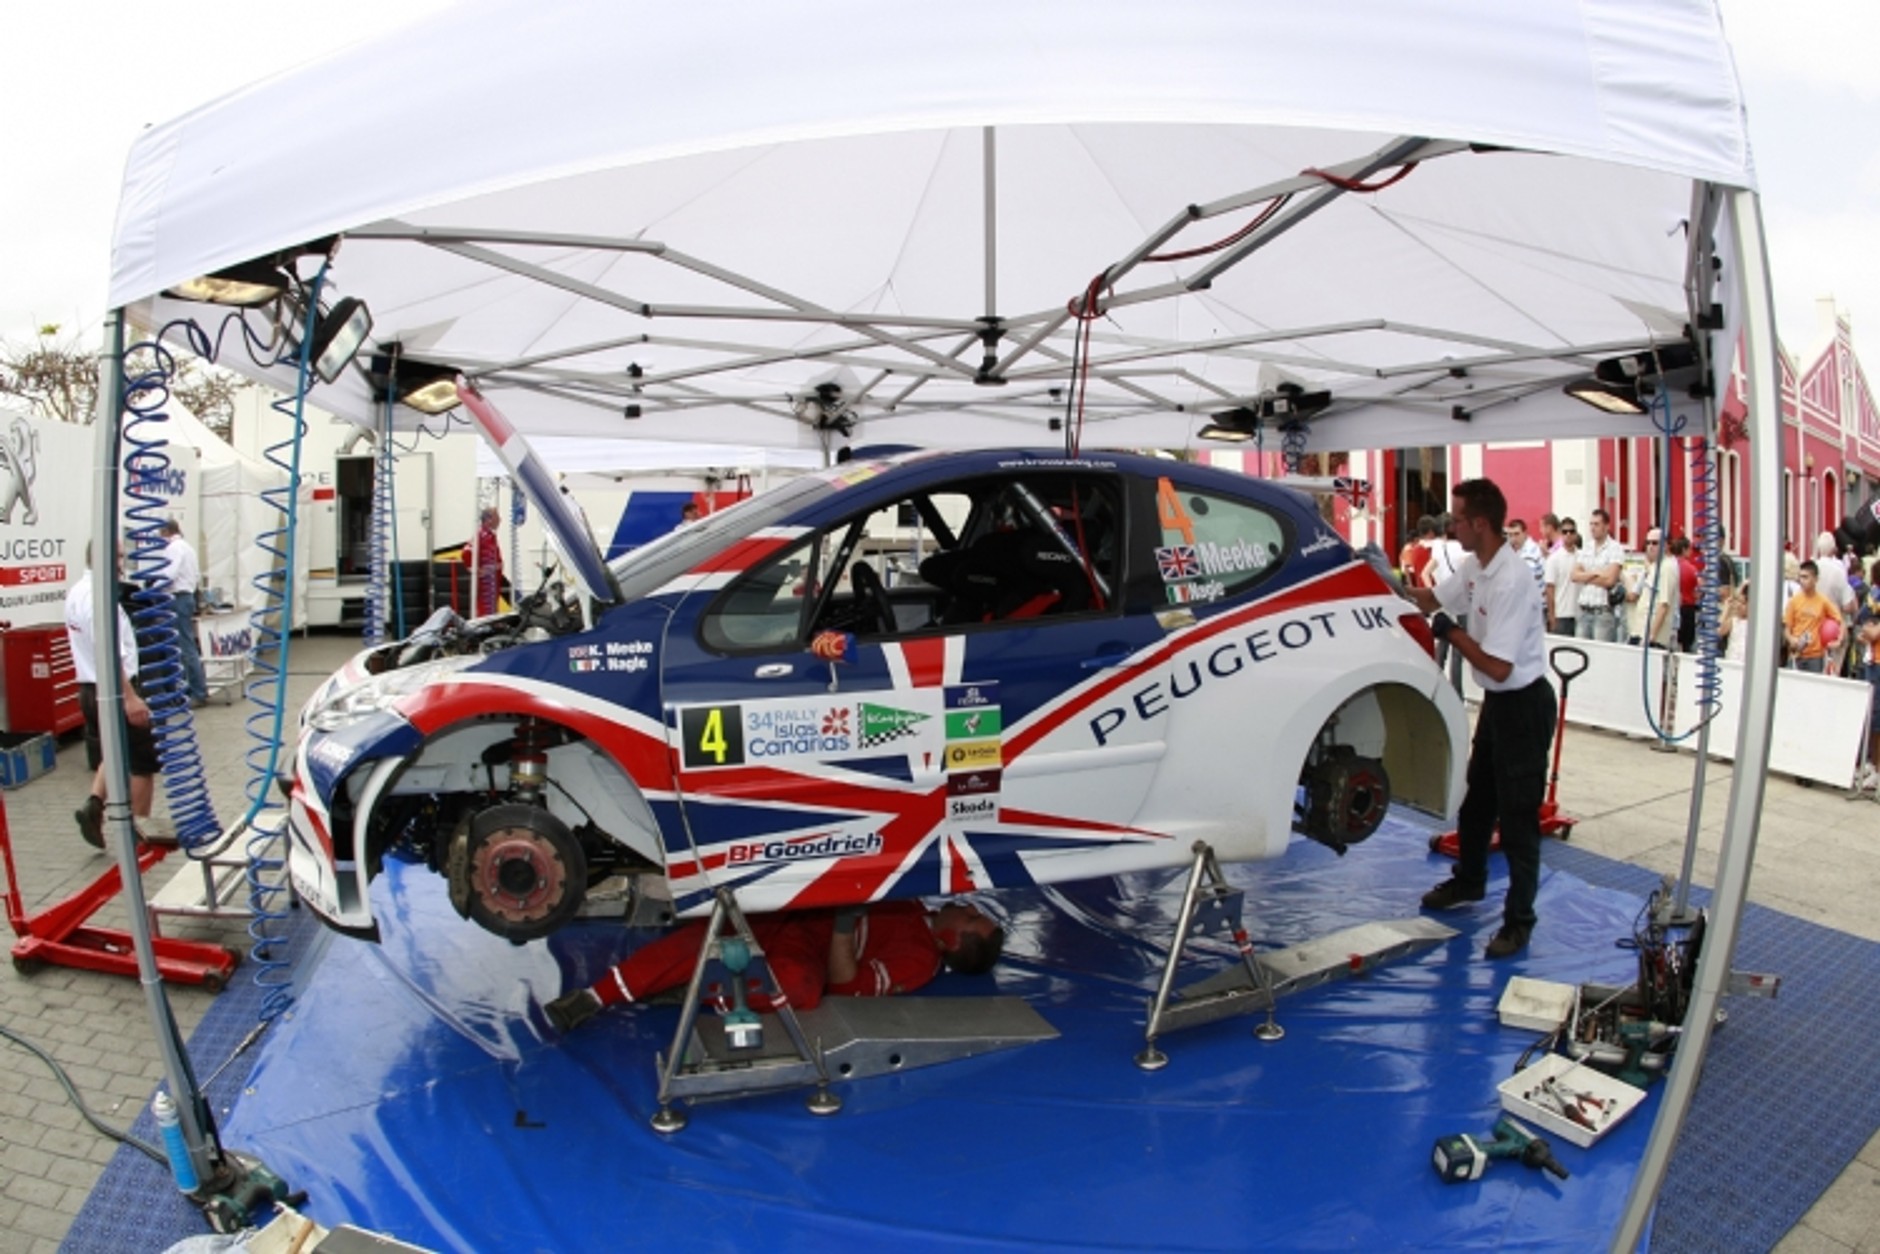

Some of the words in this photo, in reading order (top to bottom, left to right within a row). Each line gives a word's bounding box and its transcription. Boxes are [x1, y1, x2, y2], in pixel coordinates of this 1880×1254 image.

[1157, 476, 1196, 546] 4
[1199, 538, 1268, 576] Meeke
[20, 566, 64, 583] SPORT
[1188, 579, 1225, 603] Nagle
[588, 644, 603, 657] K.
[606, 640, 653, 656] Meeke
[591, 658, 605, 671] P.
[607, 656, 648, 673] Nagle
[1088, 611, 1337, 747] PEUGEOT
[1352, 606, 1394, 632] UK
[747, 711, 773, 731] 34
[774, 709, 817, 721] RALLY
[774, 722, 818, 738] Islas
[700, 708, 728, 764] 4
[748, 735, 849, 757] Canarias
[729, 832, 881, 862] BFGoodrich
